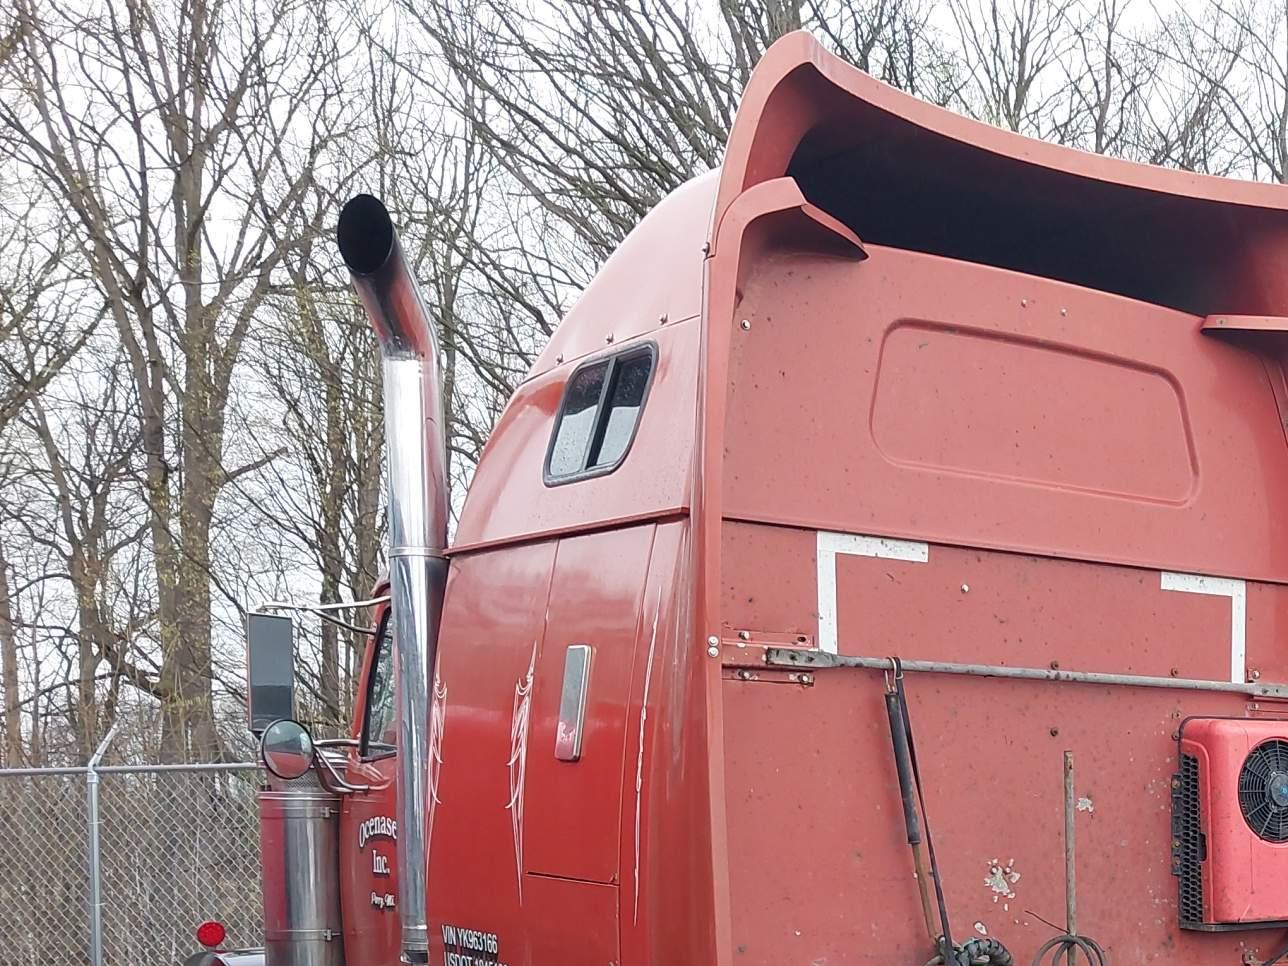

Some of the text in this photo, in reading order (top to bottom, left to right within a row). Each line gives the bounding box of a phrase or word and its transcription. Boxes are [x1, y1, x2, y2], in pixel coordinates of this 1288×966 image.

[359, 816, 398, 848] Ocenase
[372, 849, 391, 874] Inc.
[441, 924, 498, 954] VIN YK963166
